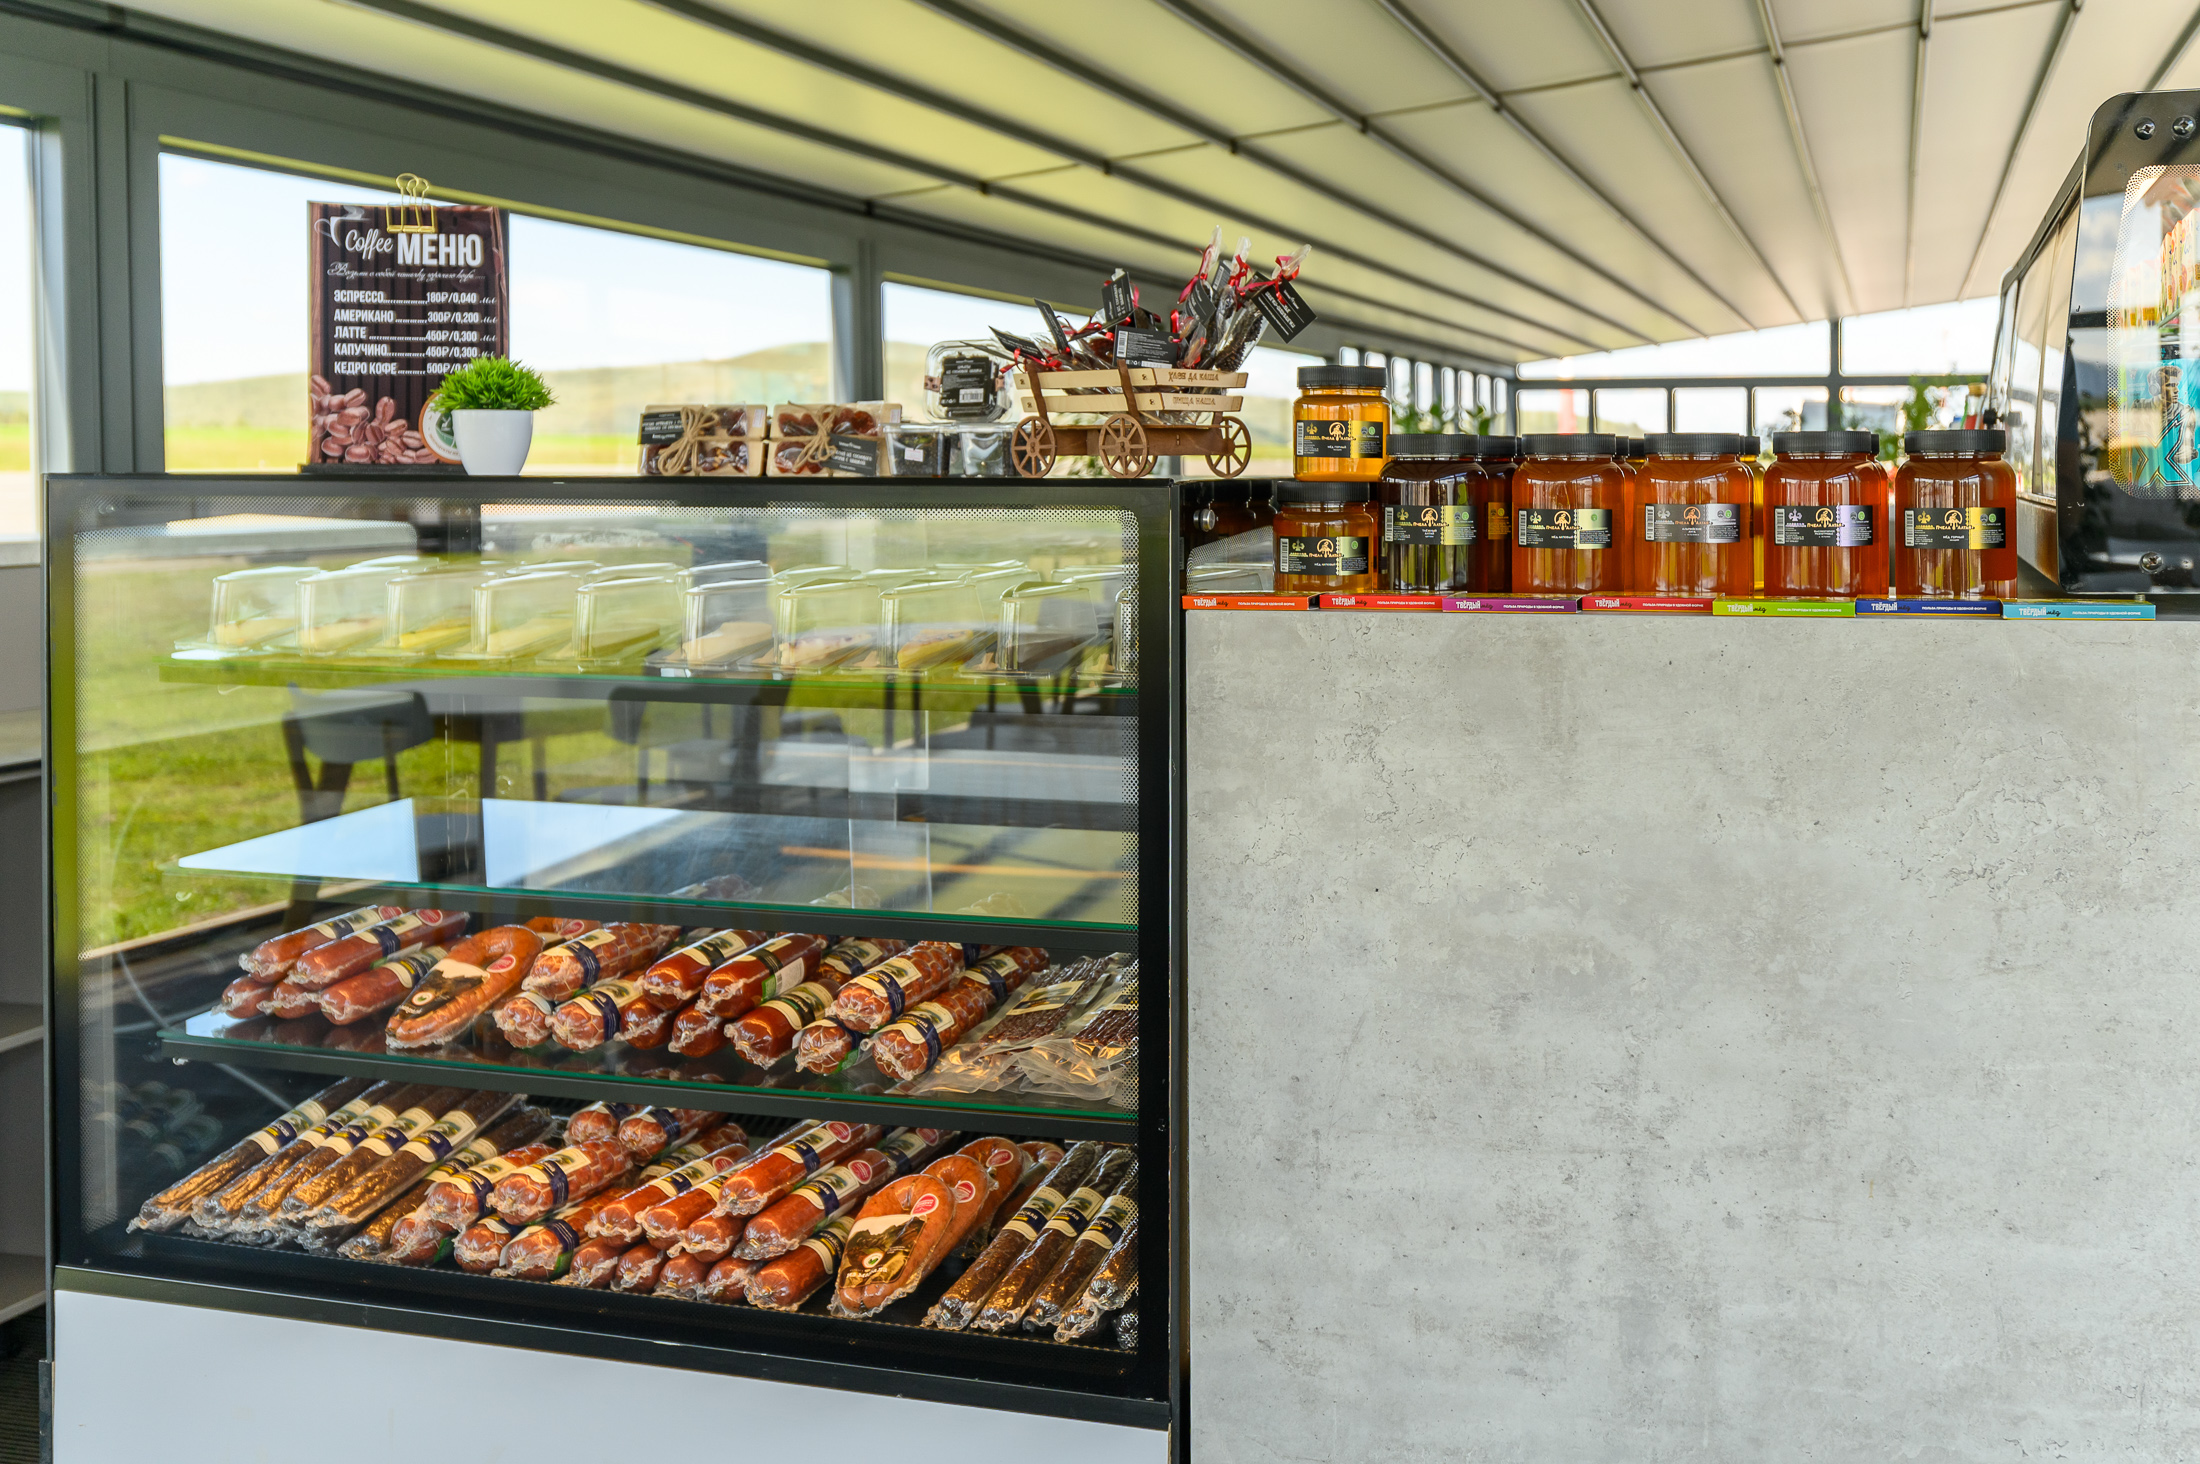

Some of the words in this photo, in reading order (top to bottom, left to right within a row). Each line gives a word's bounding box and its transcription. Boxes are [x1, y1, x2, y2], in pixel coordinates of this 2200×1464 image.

[345, 229, 394, 260] Coffee
[397, 233, 483, 266] МЕНЮ
[333, 289, 384, 303] ЭСПРЕССО
[333, 308, 394, 323] АМЕРИКАНО
[333, 325, 367, 339] ЛАТТЕ
[333, 343, 388, 356] КАПУЧИНО
[333, 361, 368, 376] КЕДРО
[369, 362, 397, 376] КОФЕ
[1168, 371, 1186, 382] ХЛЕБ
[1188, 372, 1198, 382] ДА
[1199, 373, 1219, 381] КАША
[1195, 397, 1216, 406] НАША
[1193, 597, 1217, 607] ТВЁРДЫЙ
[1332, 596, 1355, 606] ТВЁРДЫЙ
[1456, 600, 1481, 610] ТВЁРДЫЙ
[1595, 598, 1620, 608] ТВЁРДЫЙ
[1727, 603, 1753, 613] ТВЁРДЫЙ
[1871, 602, 1897, 612] ТВЁРДЫЙ
[2019, 606, 2046, 617] ТВЁРДЫЙ
